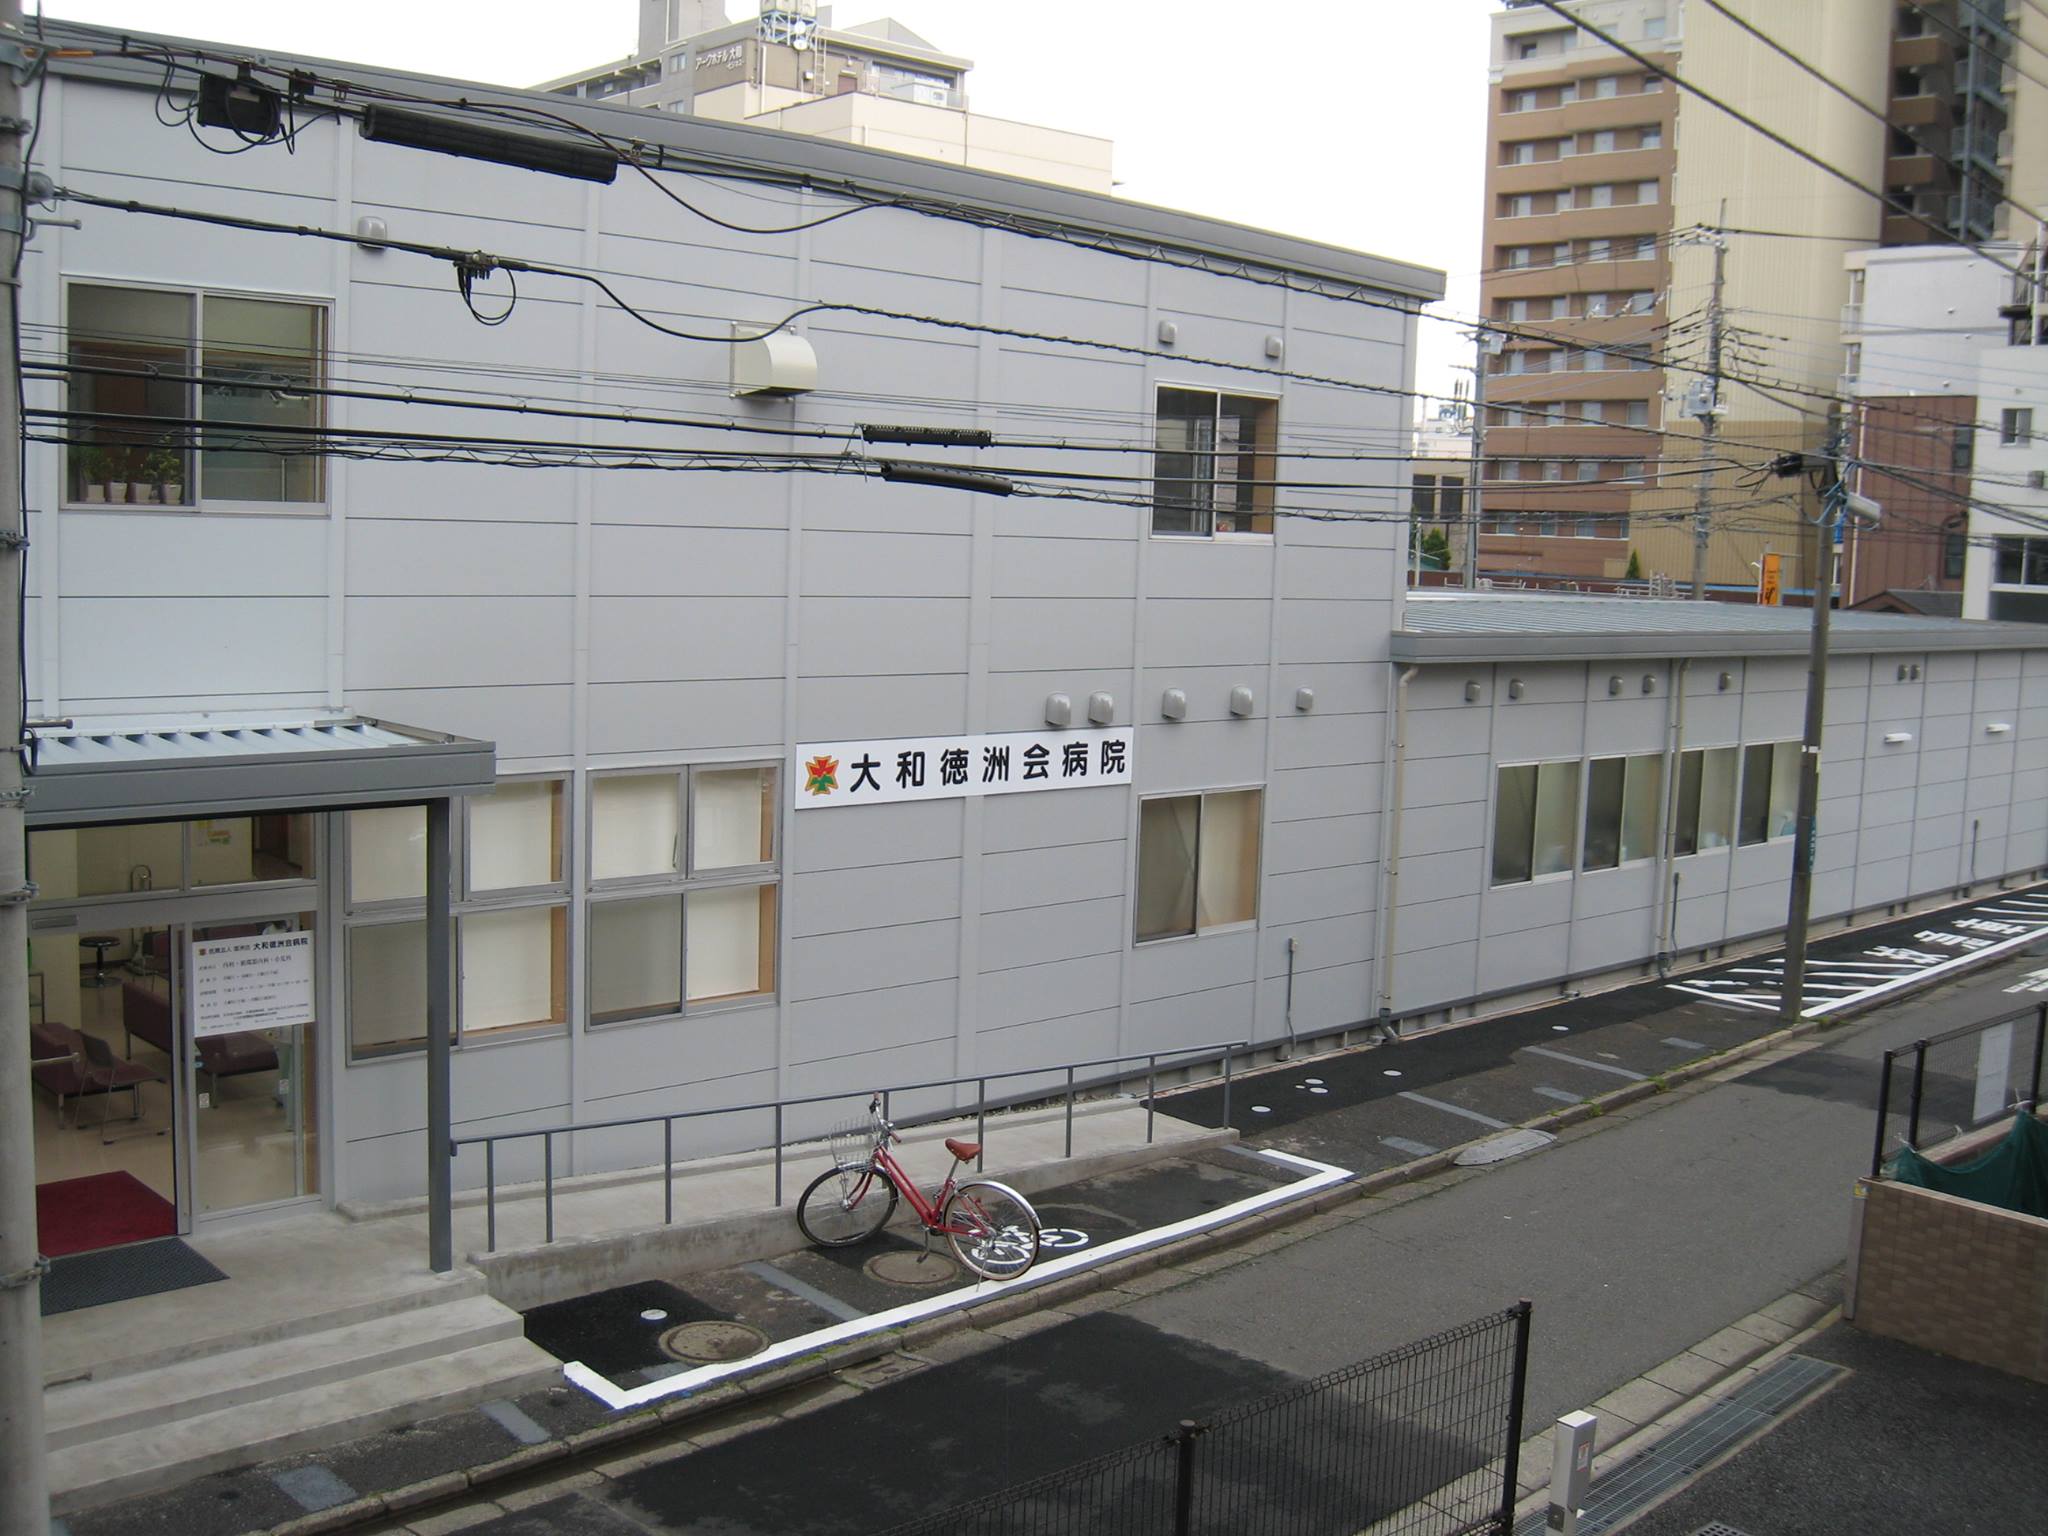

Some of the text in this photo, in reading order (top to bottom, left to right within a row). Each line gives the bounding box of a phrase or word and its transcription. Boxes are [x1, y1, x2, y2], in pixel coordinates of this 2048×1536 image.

[849, 739, 1127, 793] 大和徳洲会病院
